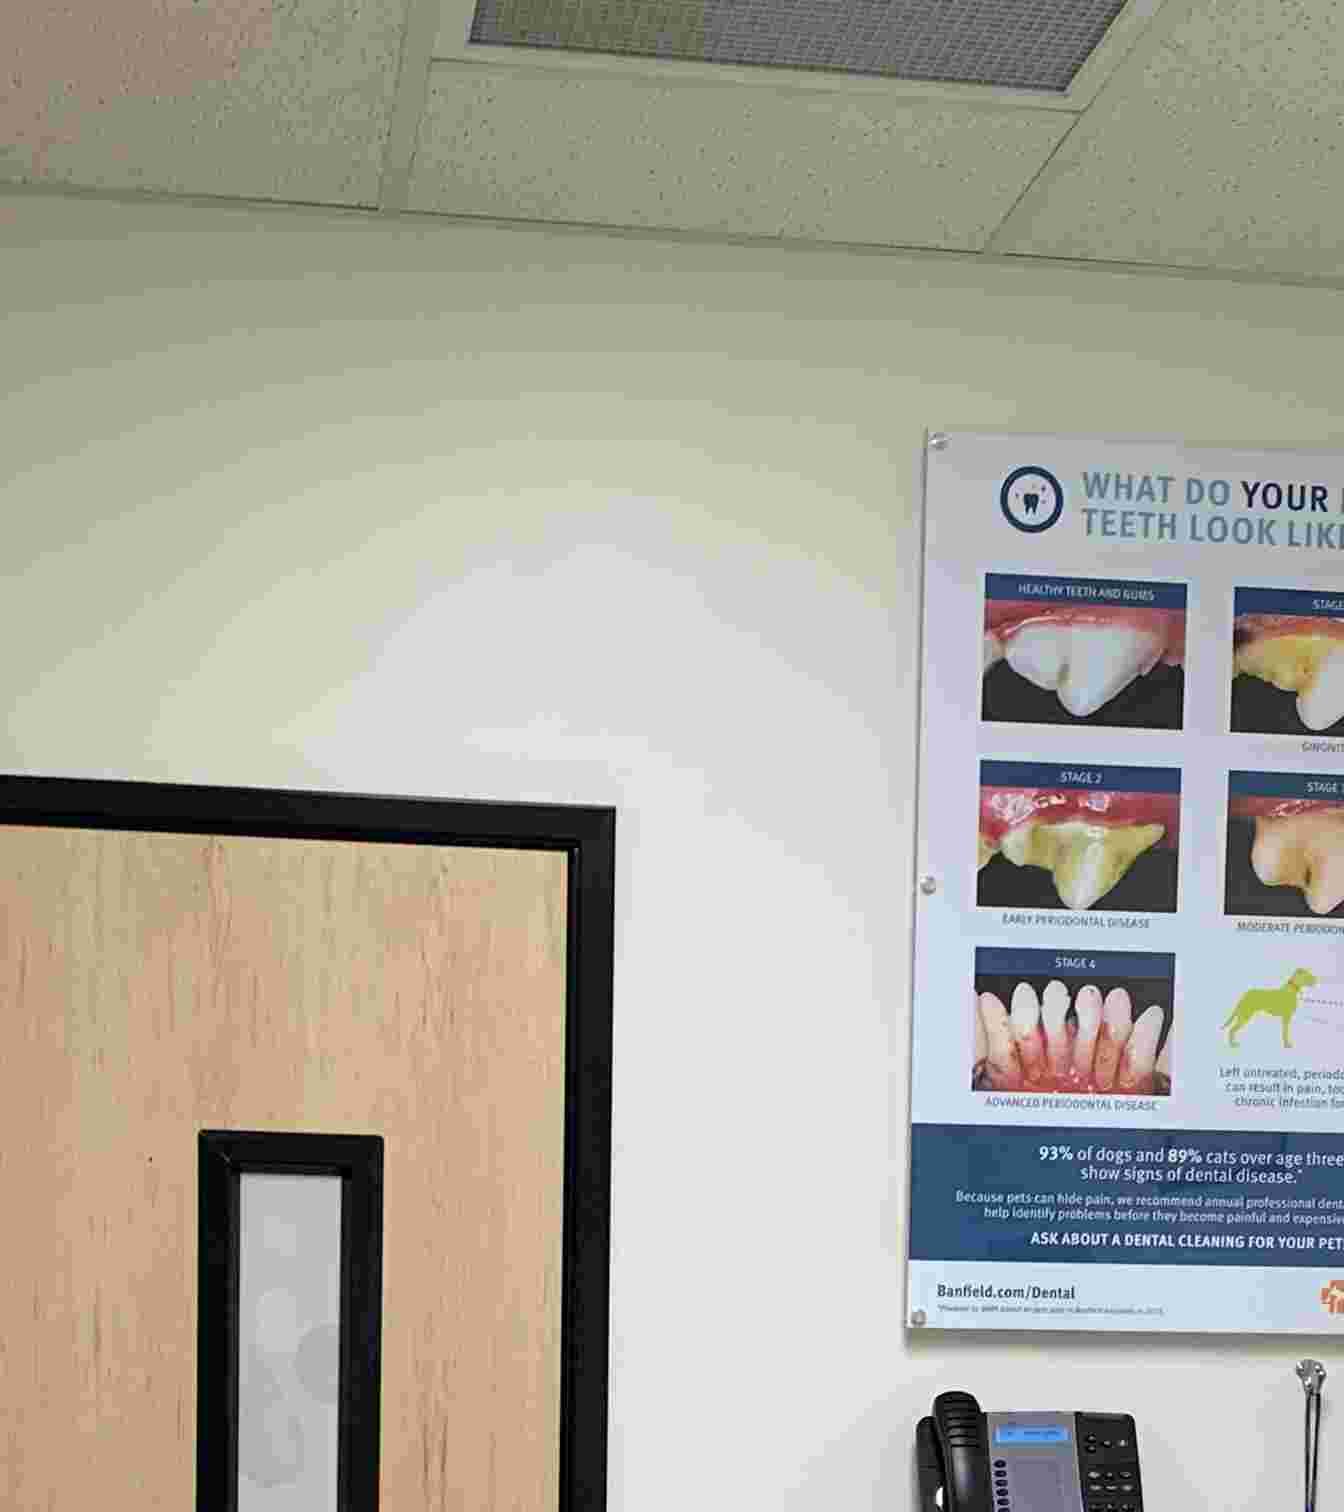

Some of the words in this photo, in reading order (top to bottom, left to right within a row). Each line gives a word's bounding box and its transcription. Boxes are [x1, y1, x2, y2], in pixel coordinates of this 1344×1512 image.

[1082, 472, 1175, 503] WHAT
[1185, 478, 1231, 506] DO
[1240, 481, 1328, 512] YOUR
[1082, 508, 1176, 540] TEETH
[1189, 513, 1276, 546] LOOK
[1018, 583, 1063, 595] HEALTHY
[1065, 585, 1097, 597] TEETH
[1098, 587, 1121, 598] AND
[1312, 600, 1344, 610] STAGE
[1061, 771, 1090, 784] STAGE
[1307, 782, 1337, 793] STAGE
[1002, 912, 1032, 925] EARLY
[1035, 913, 1105, 928] PERIODONTAL
[1108, 917, 1150, 929] DISEASE
[1055, 957, 1087, 969] STAGE
[1219, 1067, 1240, 1079] Left
[1225, 1083, 1246, 1093] can
[1249, 1081, 1280, 1093] result
[1283, 1081, 1294, 1093] in
[985, 1095, 1040, 1108] ADVANCED
[1043, 1096, 1112, 1111] PERIODONTAL
[1115, 1099, 1158, 1112] DISEASE
[1234, 1096, 1276, 1108] chronic
[1279, 1096, 1327, 1109] infection
[1039, 1146, 1073, 1161] 93%
[1077, 1146, 1094, 1161] of
[1096, 1147, 1132, 1165] dogs
[1136, 1148, 1164, 1162] and
[1167, 1149, 1202, 1163] 89%
[1206, 1150, 1237, 1164] cats
[1240, 1153, 1271, 1166] over
[1275, 1154, 1303, 1169] age
[1306, 1152, 1344, 1167] three
[1080, 1165, 1120, 1180] show
[1123, 1166, 1162, 1184] signs
[1167, 1166, 1182, 1182] of
[1185, 1167, 1233, 1183] dental
[956, 1190, 1004, 1203] Because
[1007, 1192, 1032, 1205] pets
[1033, 1194, 1055, 1205] can
[1057, 1192, 1083, 1205] hide
[1085, 1193, 1115, 1207] pain,
[1117, 1196, 1132, 1206] we
[1135, 1194, 1202, 1208] recommend
[1204, 1197, 1244, 1209] annual
[1246, 1198, 1316, 1211] professional
[984, 1207, 1009, 1219] help
[1012, 1207, 1056, 1222] identify
[1058, 1208, 1111, 1222] problems
[1114, 1209, 1150, 1221] before
[1152, 1209, 1178, 1224] they
[1180, 1211, 1225, 1223] become
[1227, 1211, 1266, 1225] painful
[1268, 1212, 1290, 1224] and
[1030, 1231, 1058, 1245] ASK
[1061, 1232, 1109, 1246] ABOUT
[1111, 1233, 1121, 1246] A
[1124, 1233, 1175, 1247] DENTAL
[1178, 1234, 1245, 1249] CLEANING
[1248, 1235, 1275, 1249] FOR
[1278, 1236, 1315, 1250] YOUR
[937, 1284, 1076, 1300] Banfield.com/Dental
